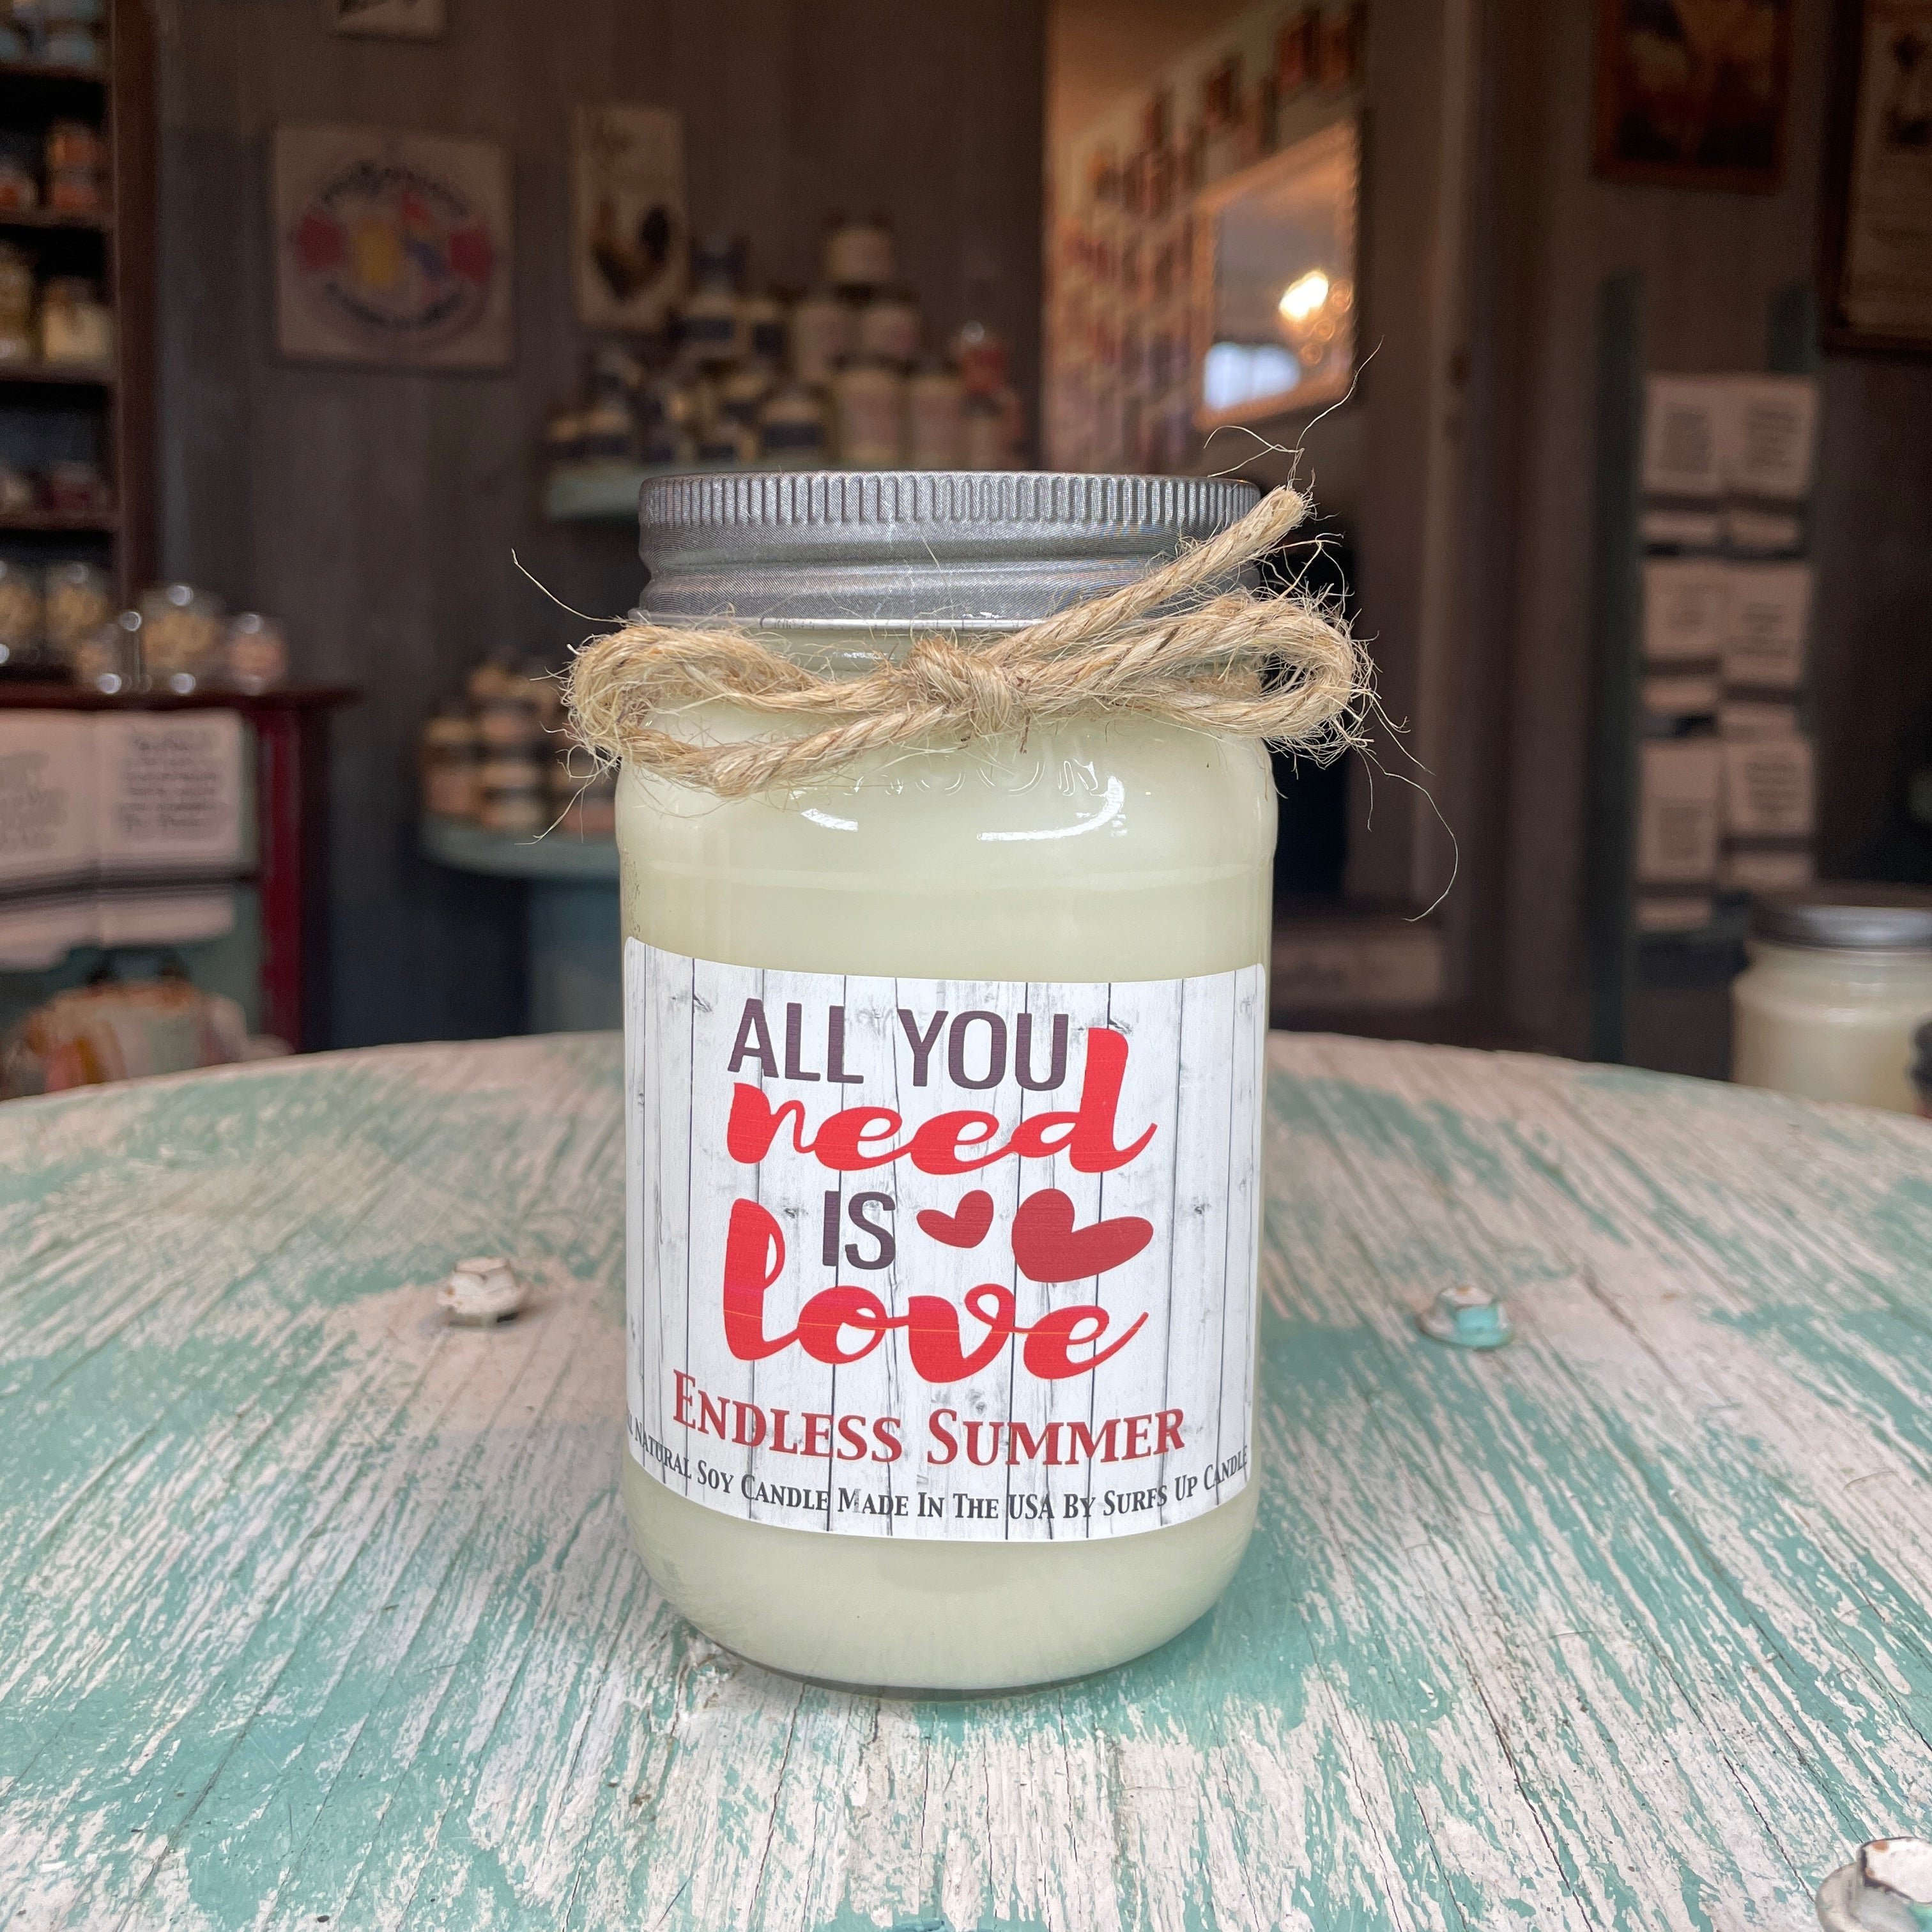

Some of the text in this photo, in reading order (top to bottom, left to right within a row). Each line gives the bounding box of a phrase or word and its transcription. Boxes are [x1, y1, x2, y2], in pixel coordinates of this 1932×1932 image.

[728, 998, 1068, 1091] ALL YOU
[727, 1027, 1157, 1175] need
[822, 1190, 895, 1270] IS
[723, 1199, 1148, 1384] love
[673, 1368, 1185, 1466] ENDLESS SUMMER
[634, 1416, 692, 1480] NATURAL
[698, 1460, 734, 1494] SOY
[741, 1474, 831, 1511] CANDLE
[917, 1492, 945, 1518] IN
[953, 1493, 999, 1519] THE
[1008, 1494, 1054, 1519] USA
[1063, 1493, 1096, 1519] BY
[1174, 1475, 1197, 1501] UP
